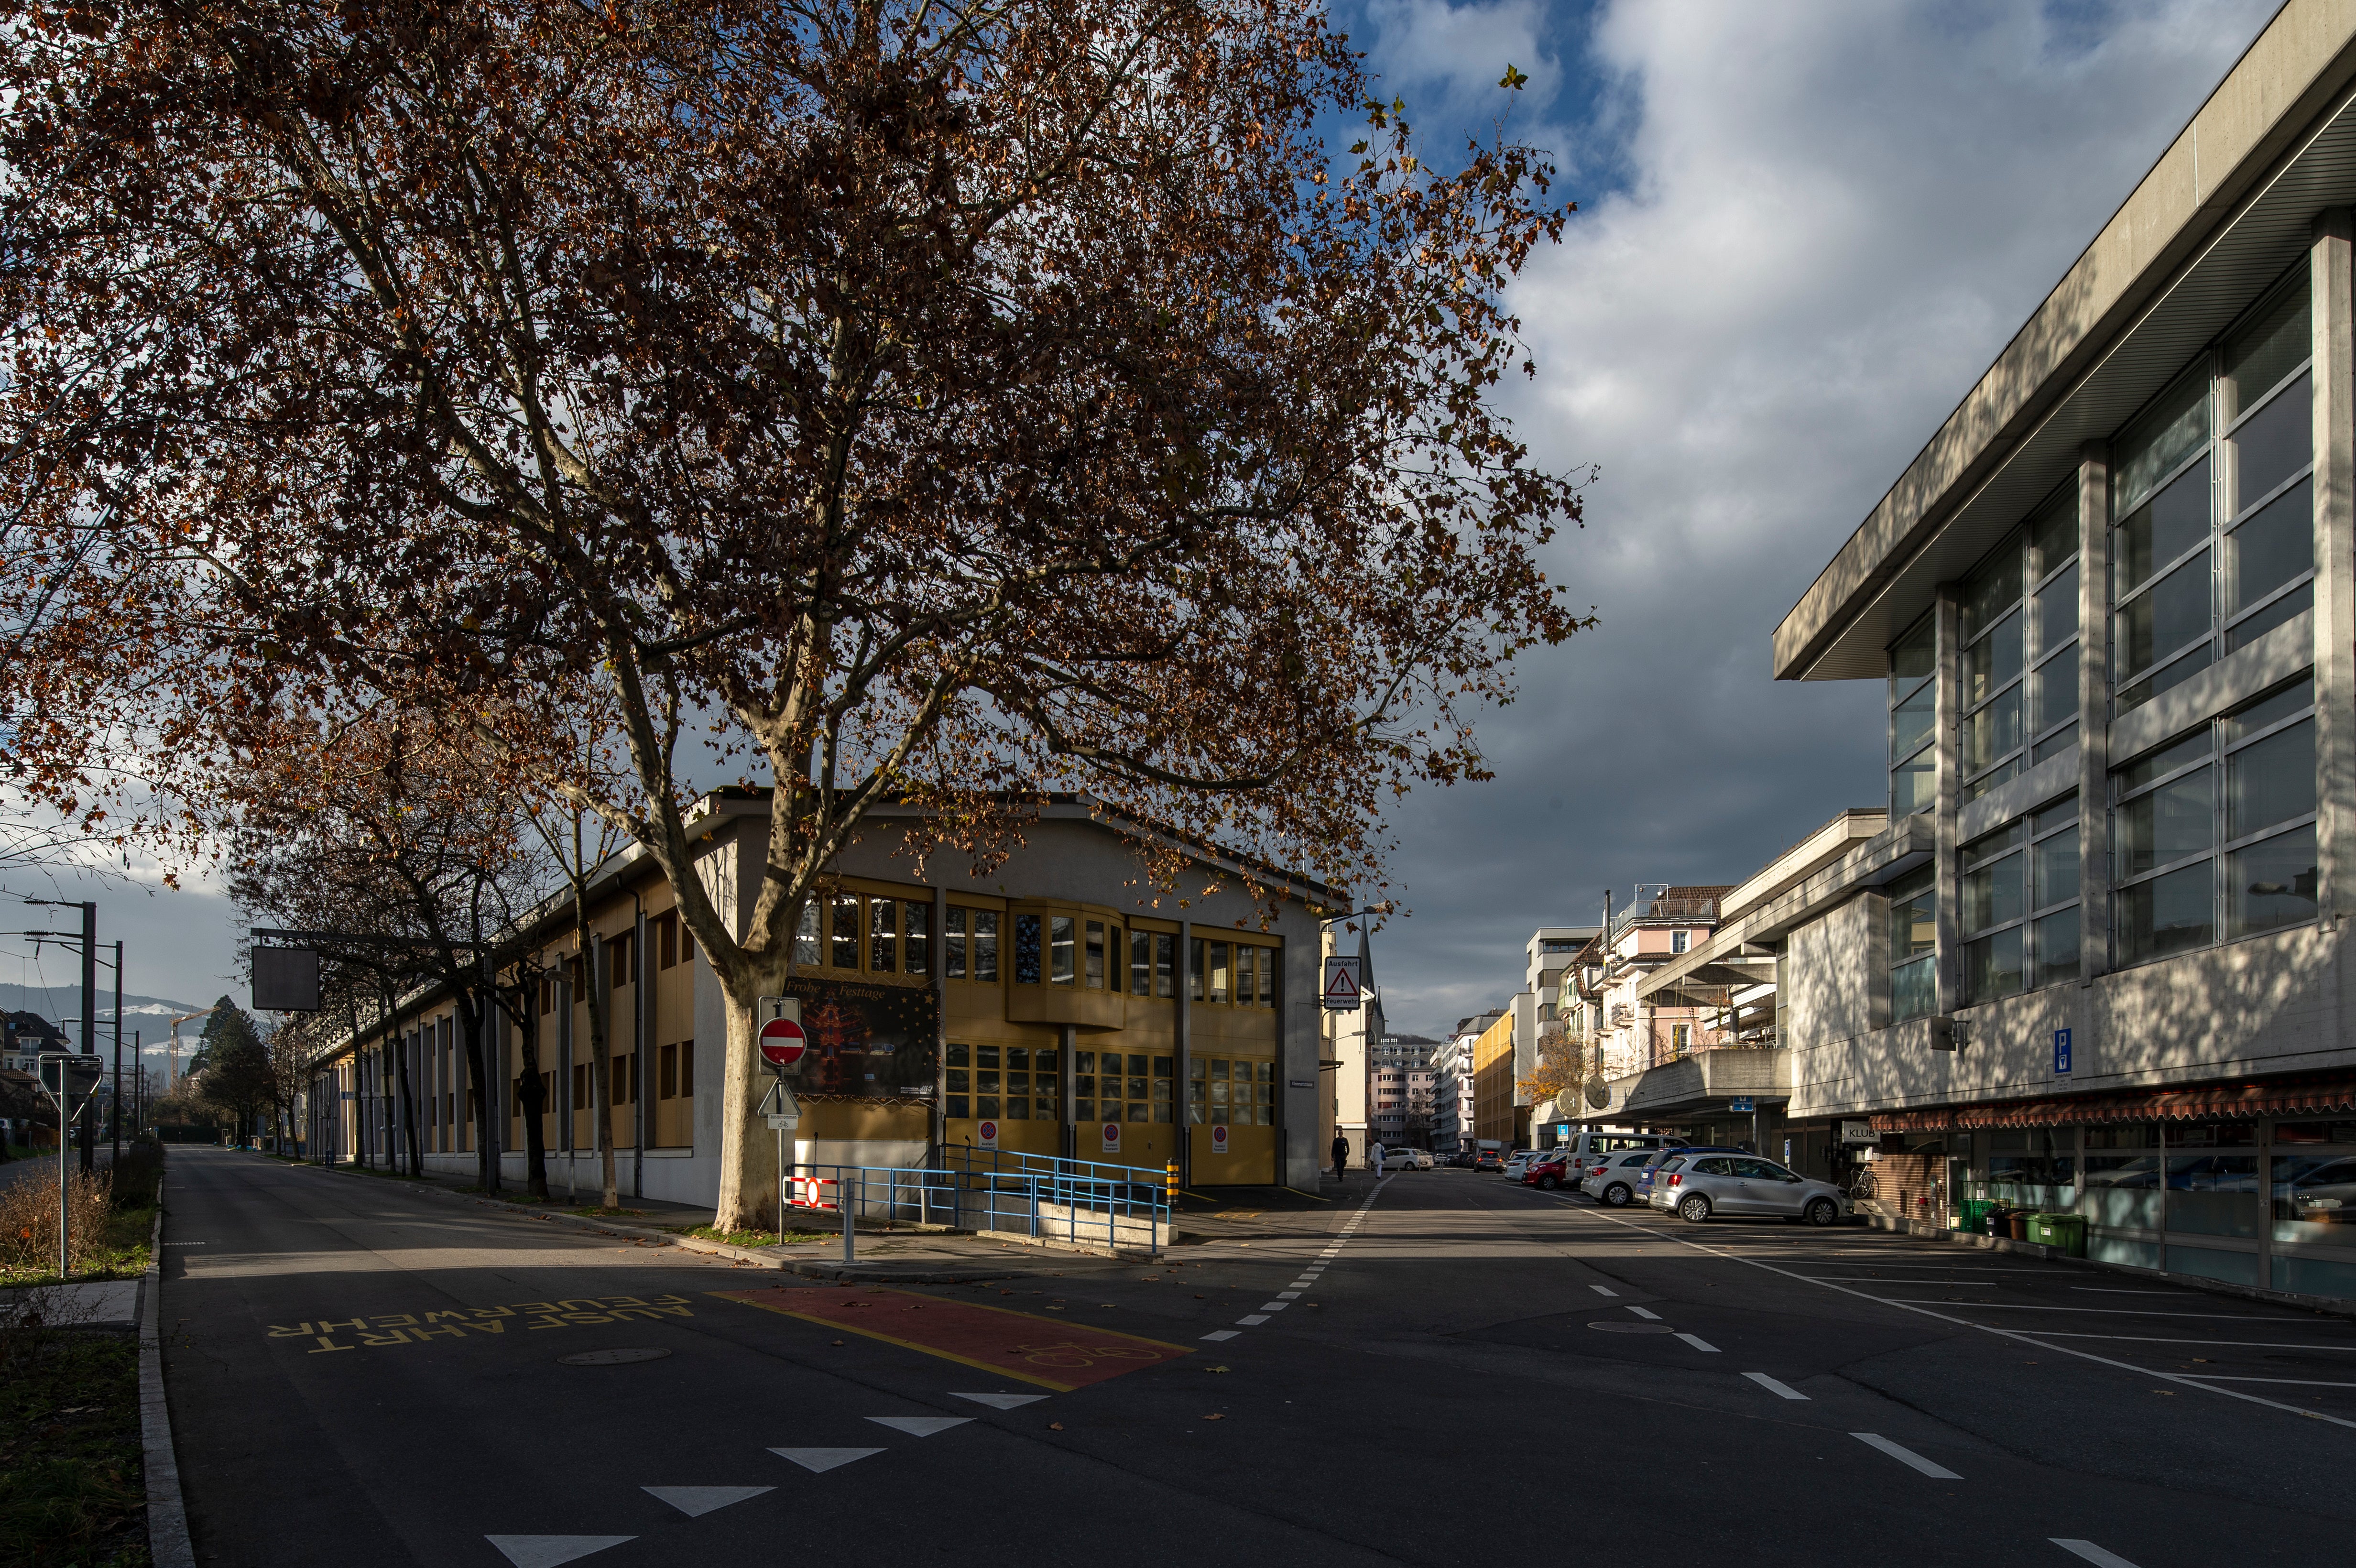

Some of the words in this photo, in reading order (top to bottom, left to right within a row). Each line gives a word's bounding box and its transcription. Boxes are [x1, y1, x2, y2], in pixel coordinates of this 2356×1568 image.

[785, 980, 821, 993] Frohe
[839, 986, 885, 1001] Festtage
[2059, 1033, 2066, 1054] P
[1849, 1129, 1875, 1137] KLUB
[267, 1294, 693, 1337] FEUERWEHR
[307, 1306, 695, 1354] AUSFAHRT
